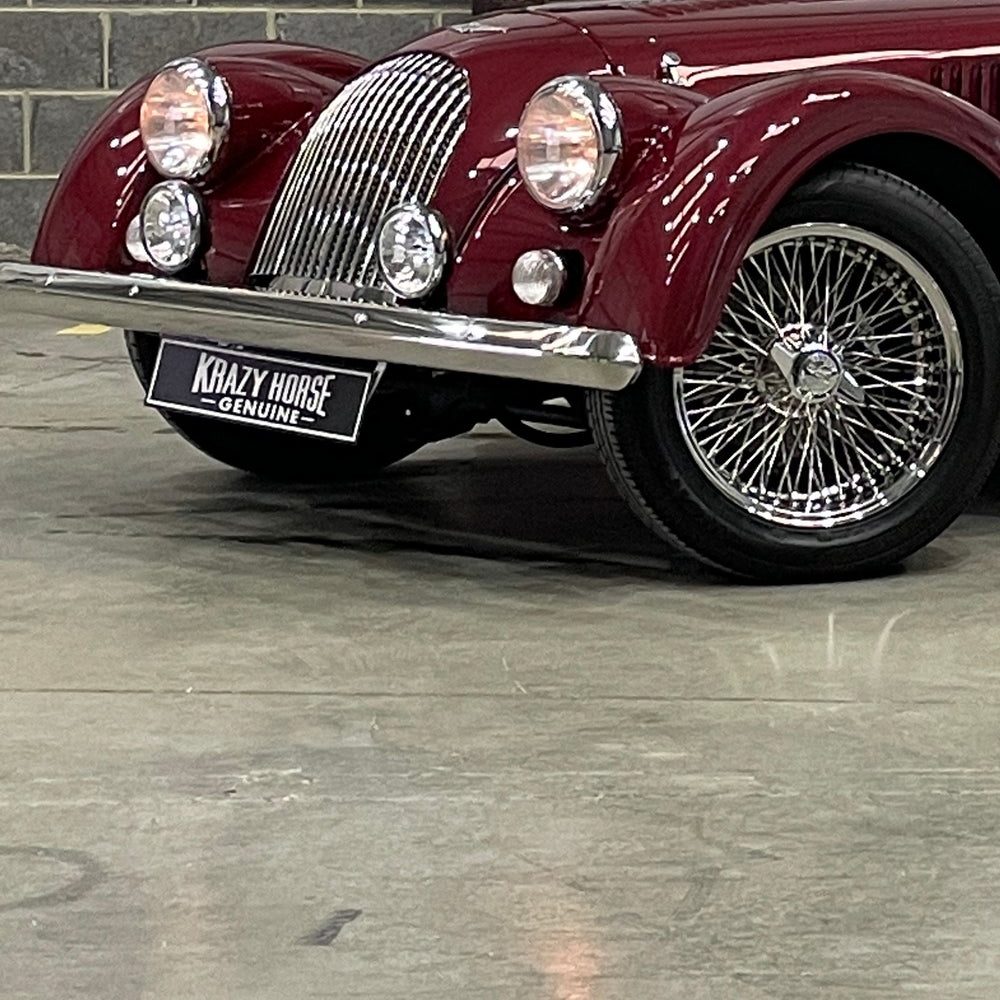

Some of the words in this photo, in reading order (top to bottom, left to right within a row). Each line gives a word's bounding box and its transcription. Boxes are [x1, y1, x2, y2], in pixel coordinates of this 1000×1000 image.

[191, 352, 269, 397] KRAZY
[268, 373, 336, 417] HORSE
[218, 398, 300, 425] GENUINE
